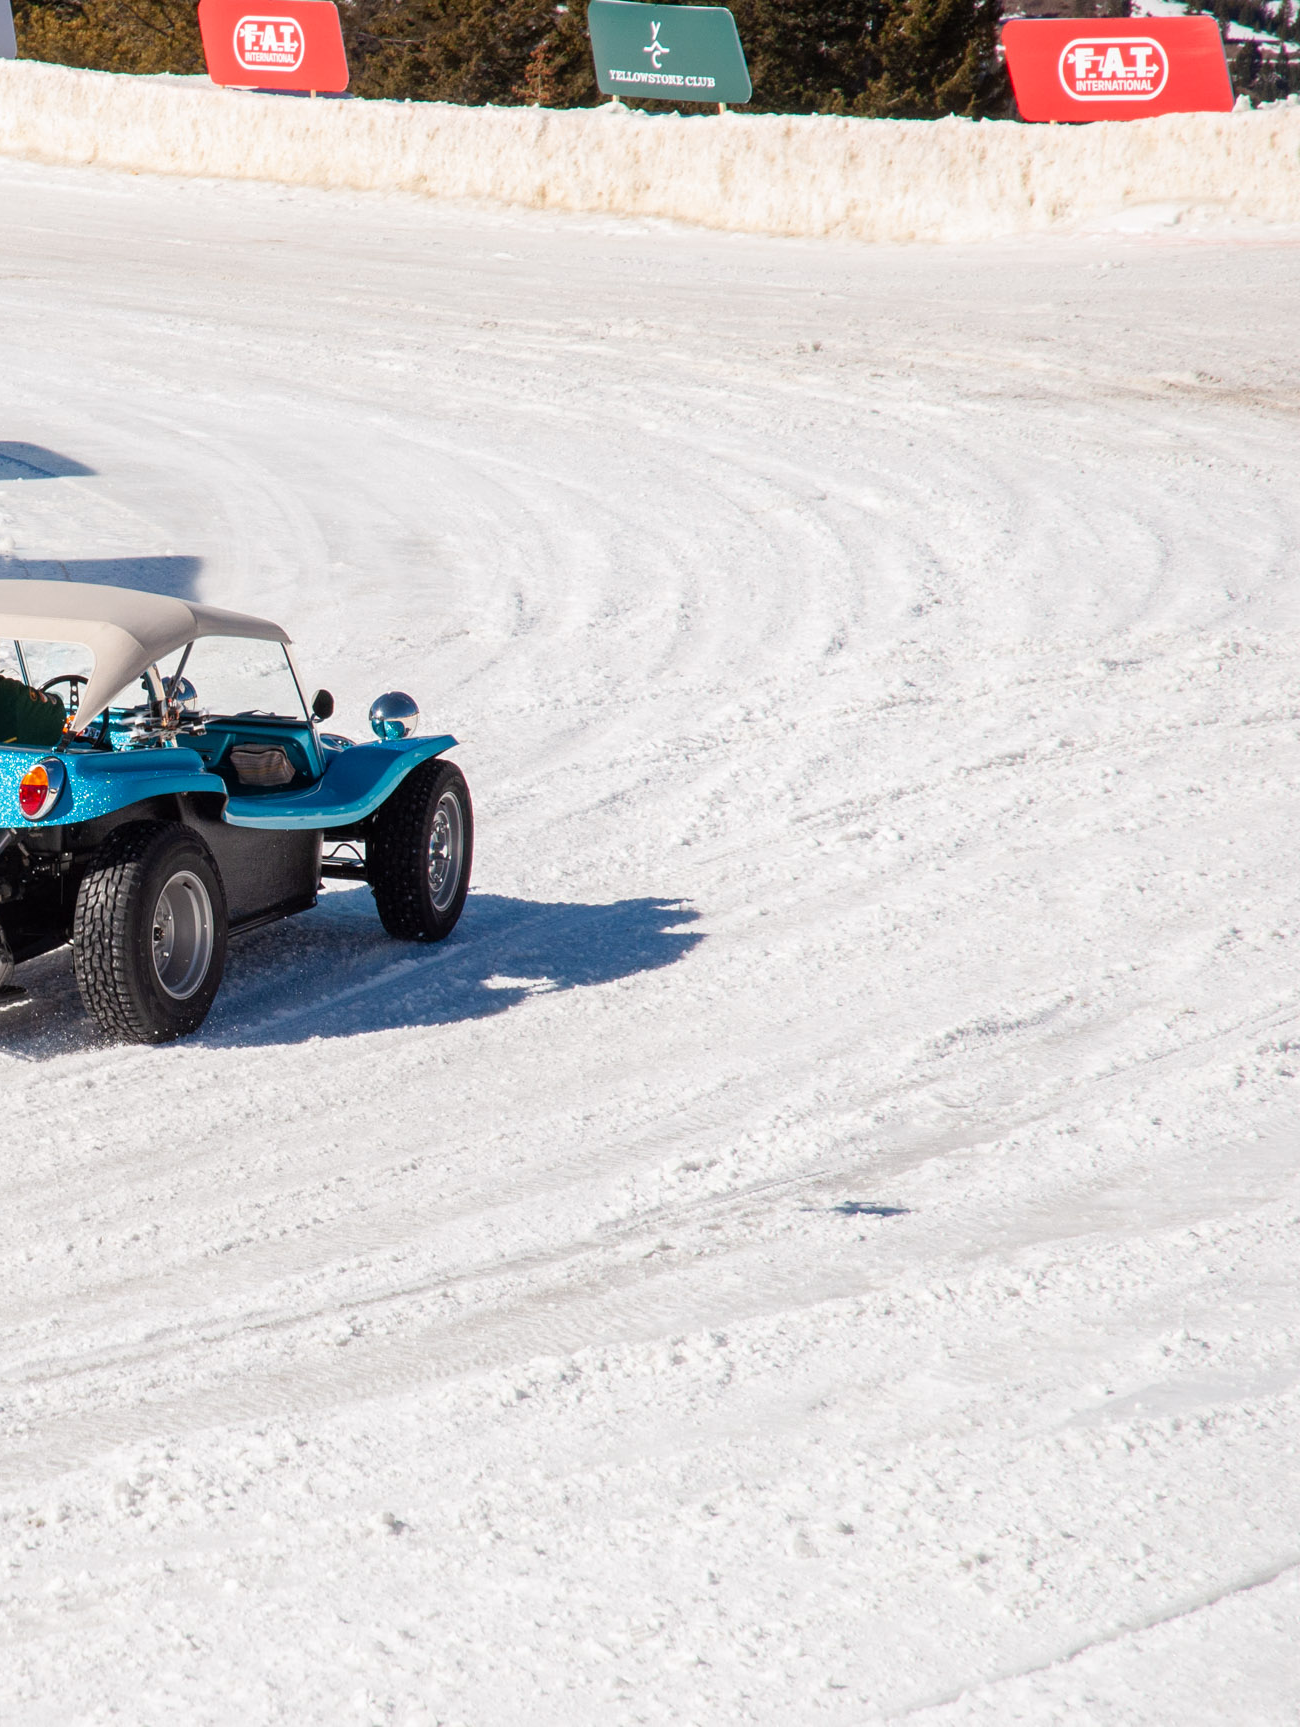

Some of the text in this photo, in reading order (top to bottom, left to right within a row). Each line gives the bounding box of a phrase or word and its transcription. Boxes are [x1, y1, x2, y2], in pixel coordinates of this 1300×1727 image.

[244, 24, 296, 52] F.A.T.
[244, 51, 296, 64] INTERNATIONAL
[1075, 47, 1154, 79] F.A.T.
[609, 69, 716, 88] YELLOWSTONE CLUB
[1076, 79, 1154, 92] INTERNATIONAL
